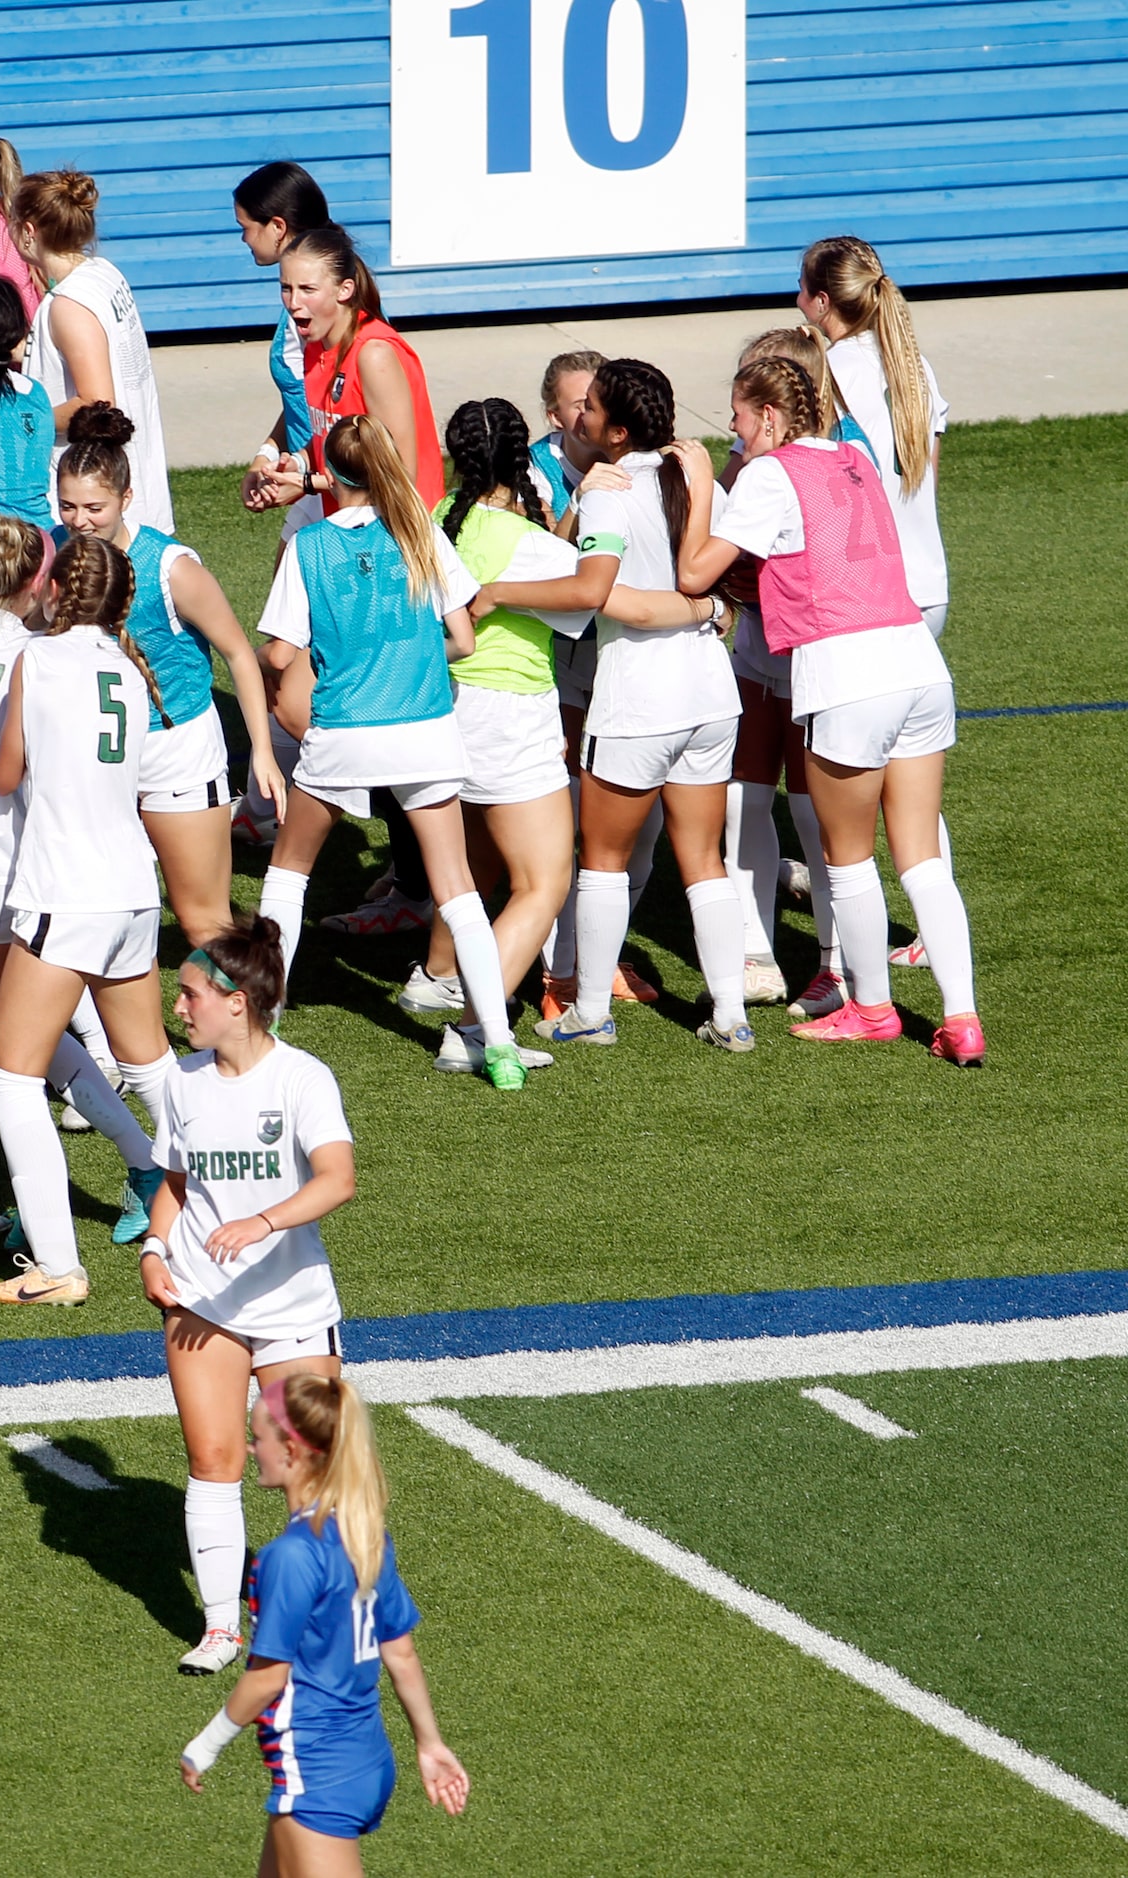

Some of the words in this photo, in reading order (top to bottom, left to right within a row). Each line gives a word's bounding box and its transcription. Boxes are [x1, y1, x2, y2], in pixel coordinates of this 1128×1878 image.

[450, 0, 688, 174] 10
[581, 536, 597, 552] C
[97, 671, 127, 764] 5
[187, 1150, 283, 1181] PROSPER
[352, 1588, 380, 1665] 12
